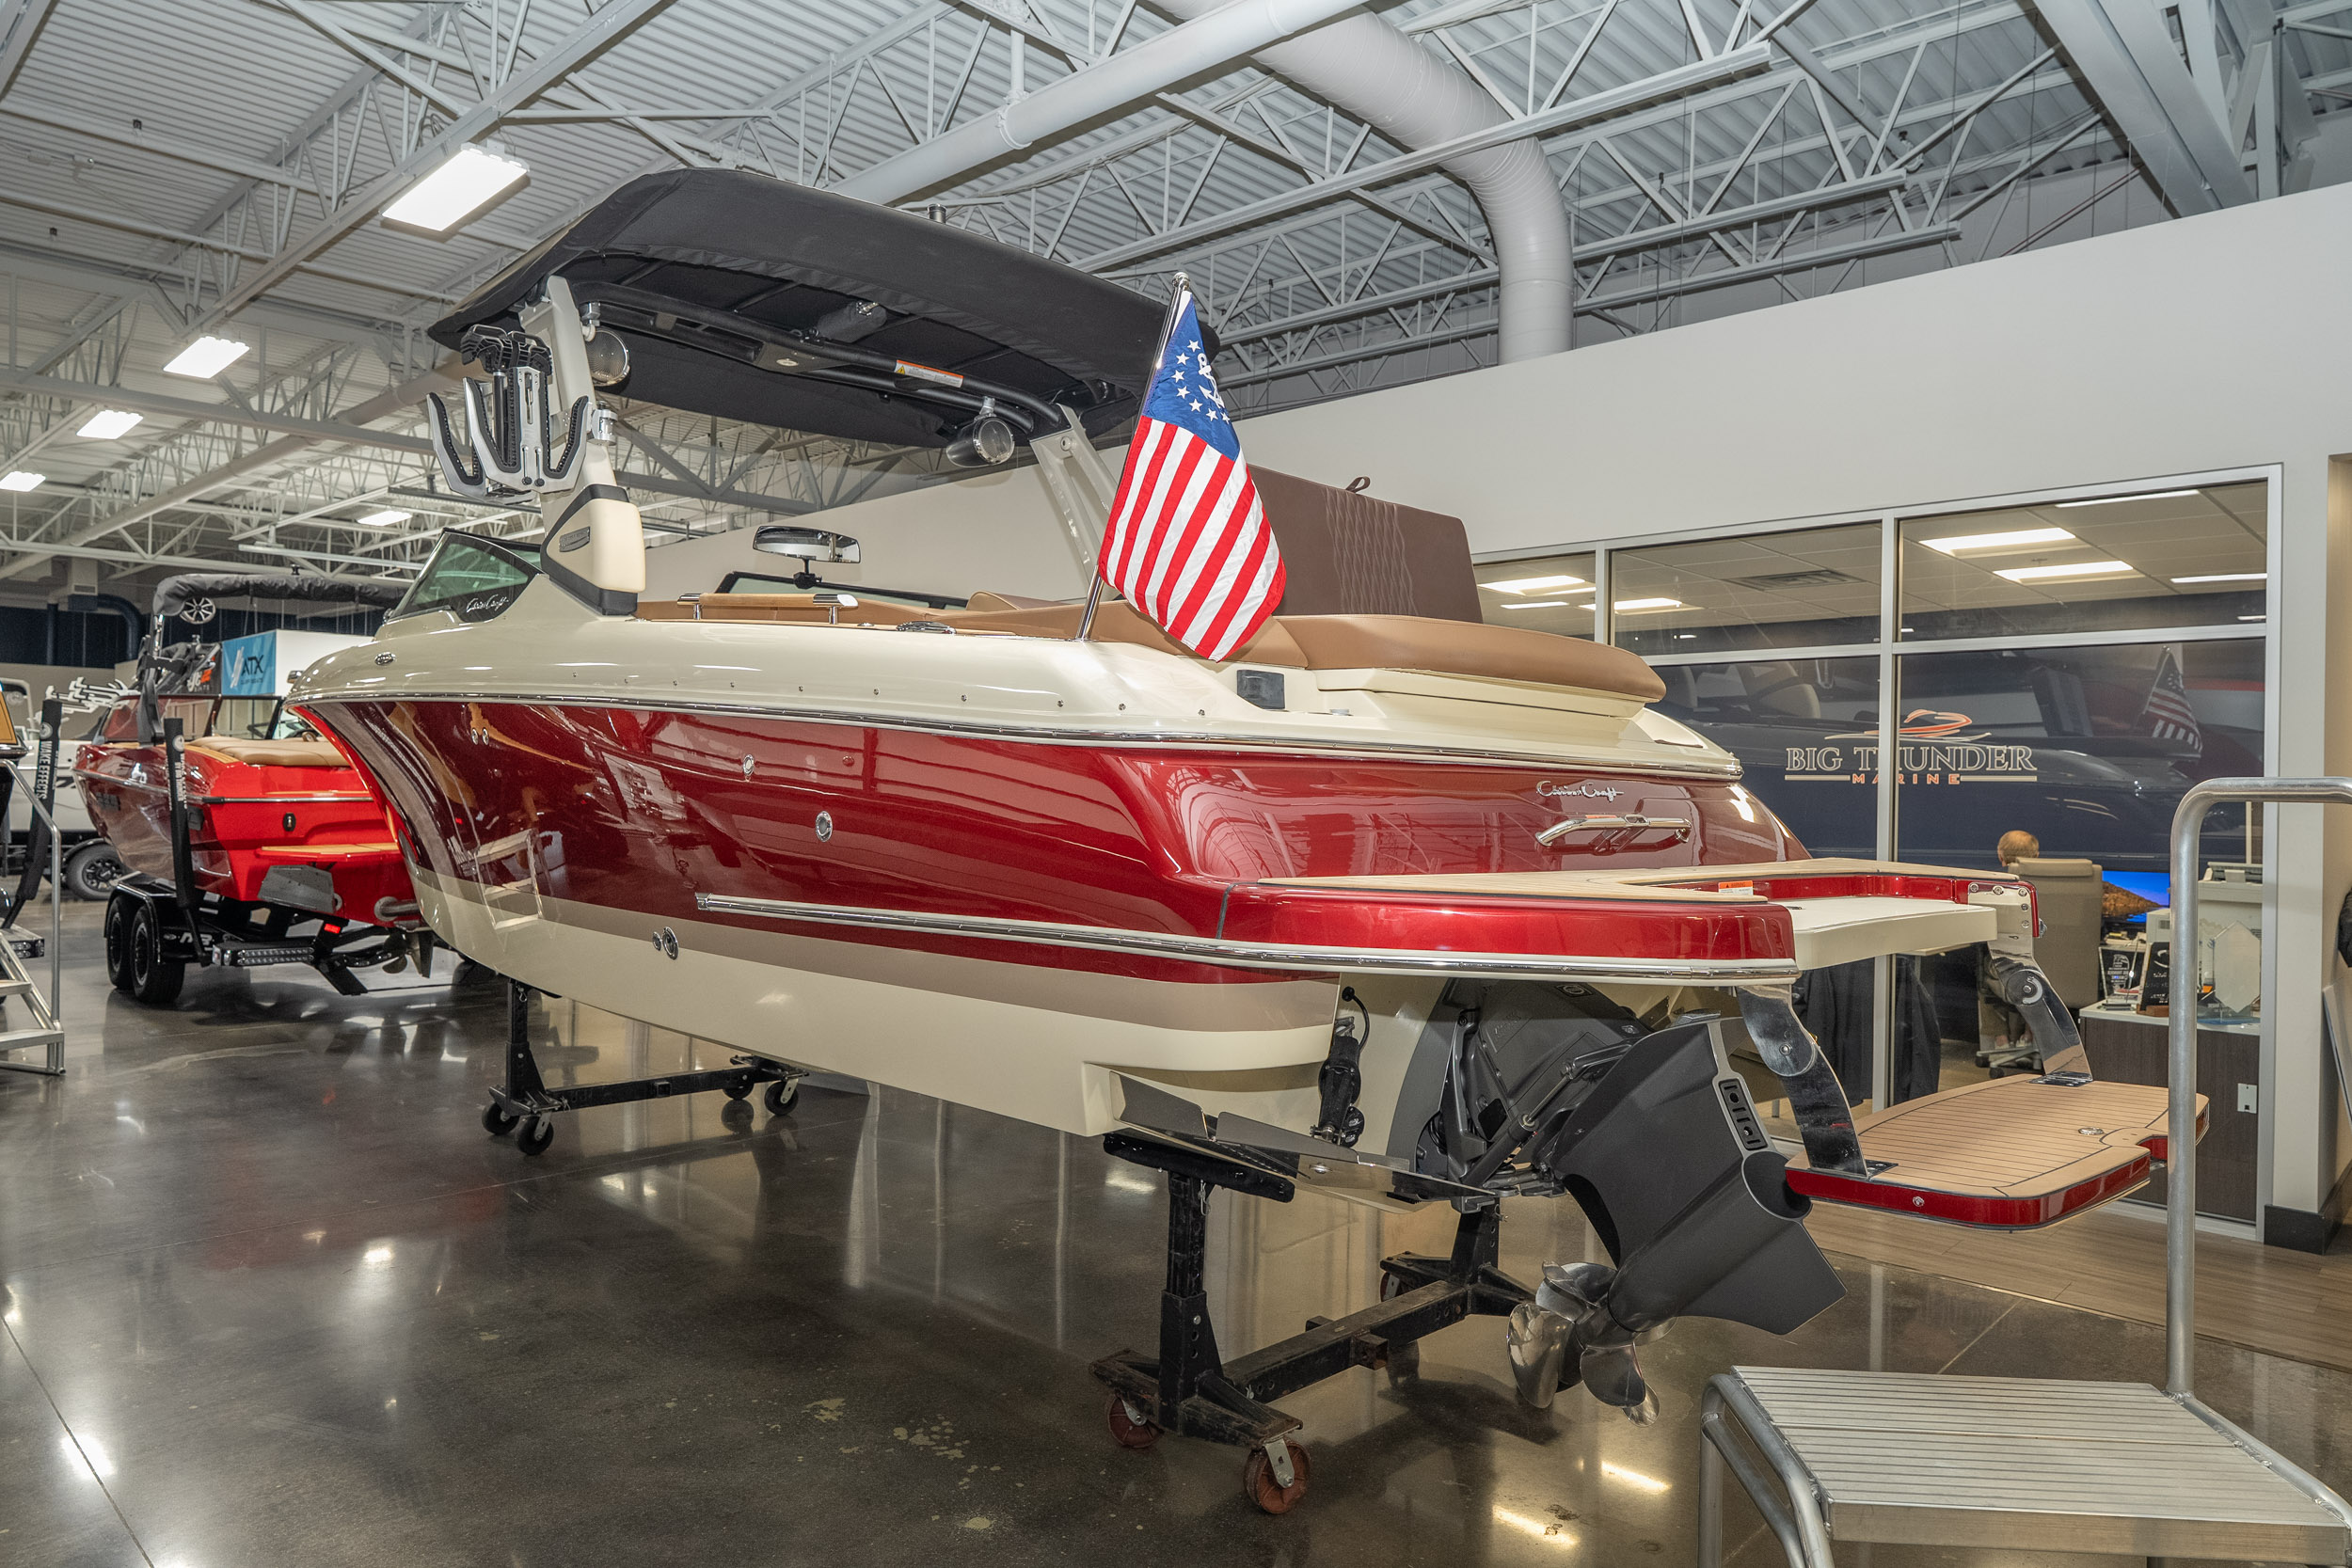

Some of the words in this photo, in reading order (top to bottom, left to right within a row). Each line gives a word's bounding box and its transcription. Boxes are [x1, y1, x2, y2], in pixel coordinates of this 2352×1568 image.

[241, 654, 264, 676] ATX
[39, 740, 53, 765] WAKE
[1786, 746, 1843, 771] BIG
[1853, 746, 2038, 771] TUNDER
[36, 765, 51, 800] EFFECTS
